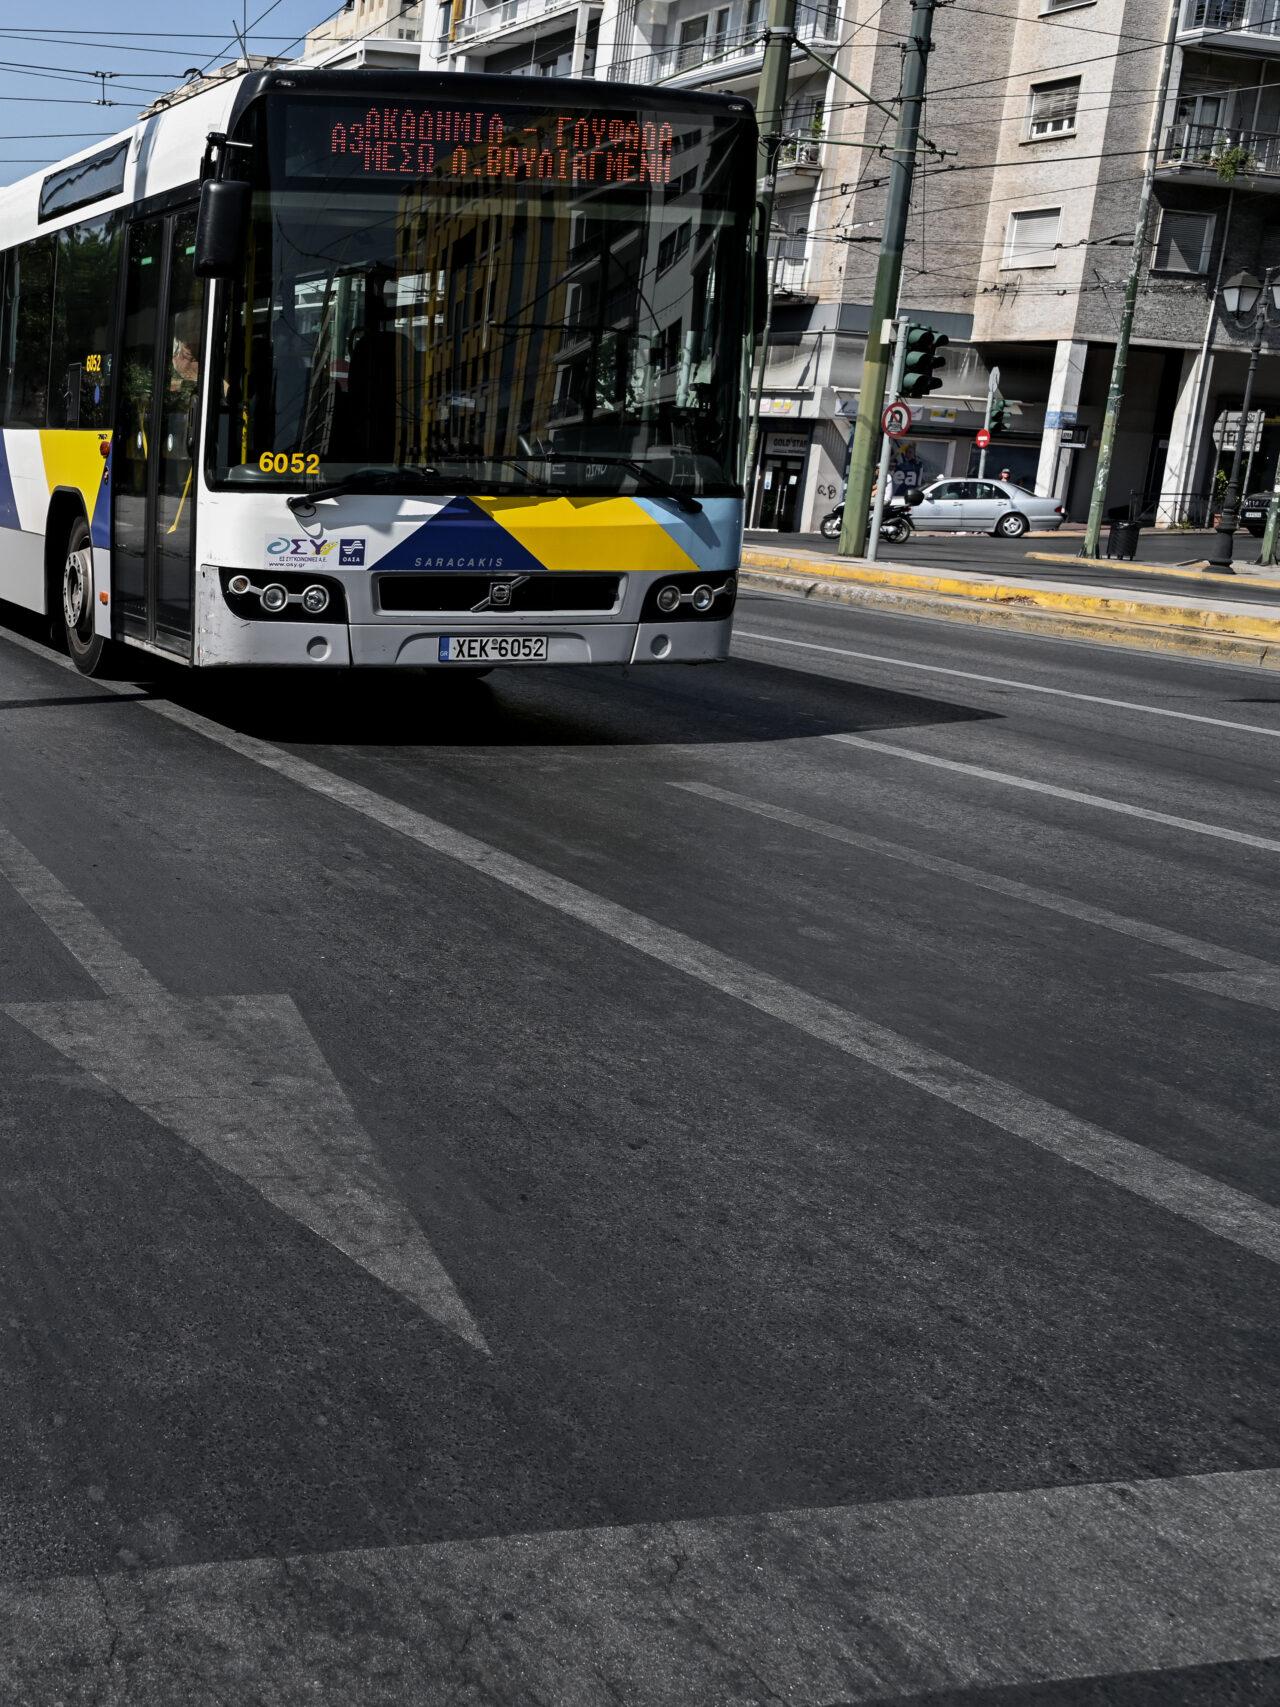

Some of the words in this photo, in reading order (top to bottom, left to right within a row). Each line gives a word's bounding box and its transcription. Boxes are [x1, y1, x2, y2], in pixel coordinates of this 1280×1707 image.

[86, 354, 102, 372] 6052
[773, 438, 790, 447] GOLD
[259, 451, 320, 474] 6052
[414, 558, 504, 567] SARACAKIS
